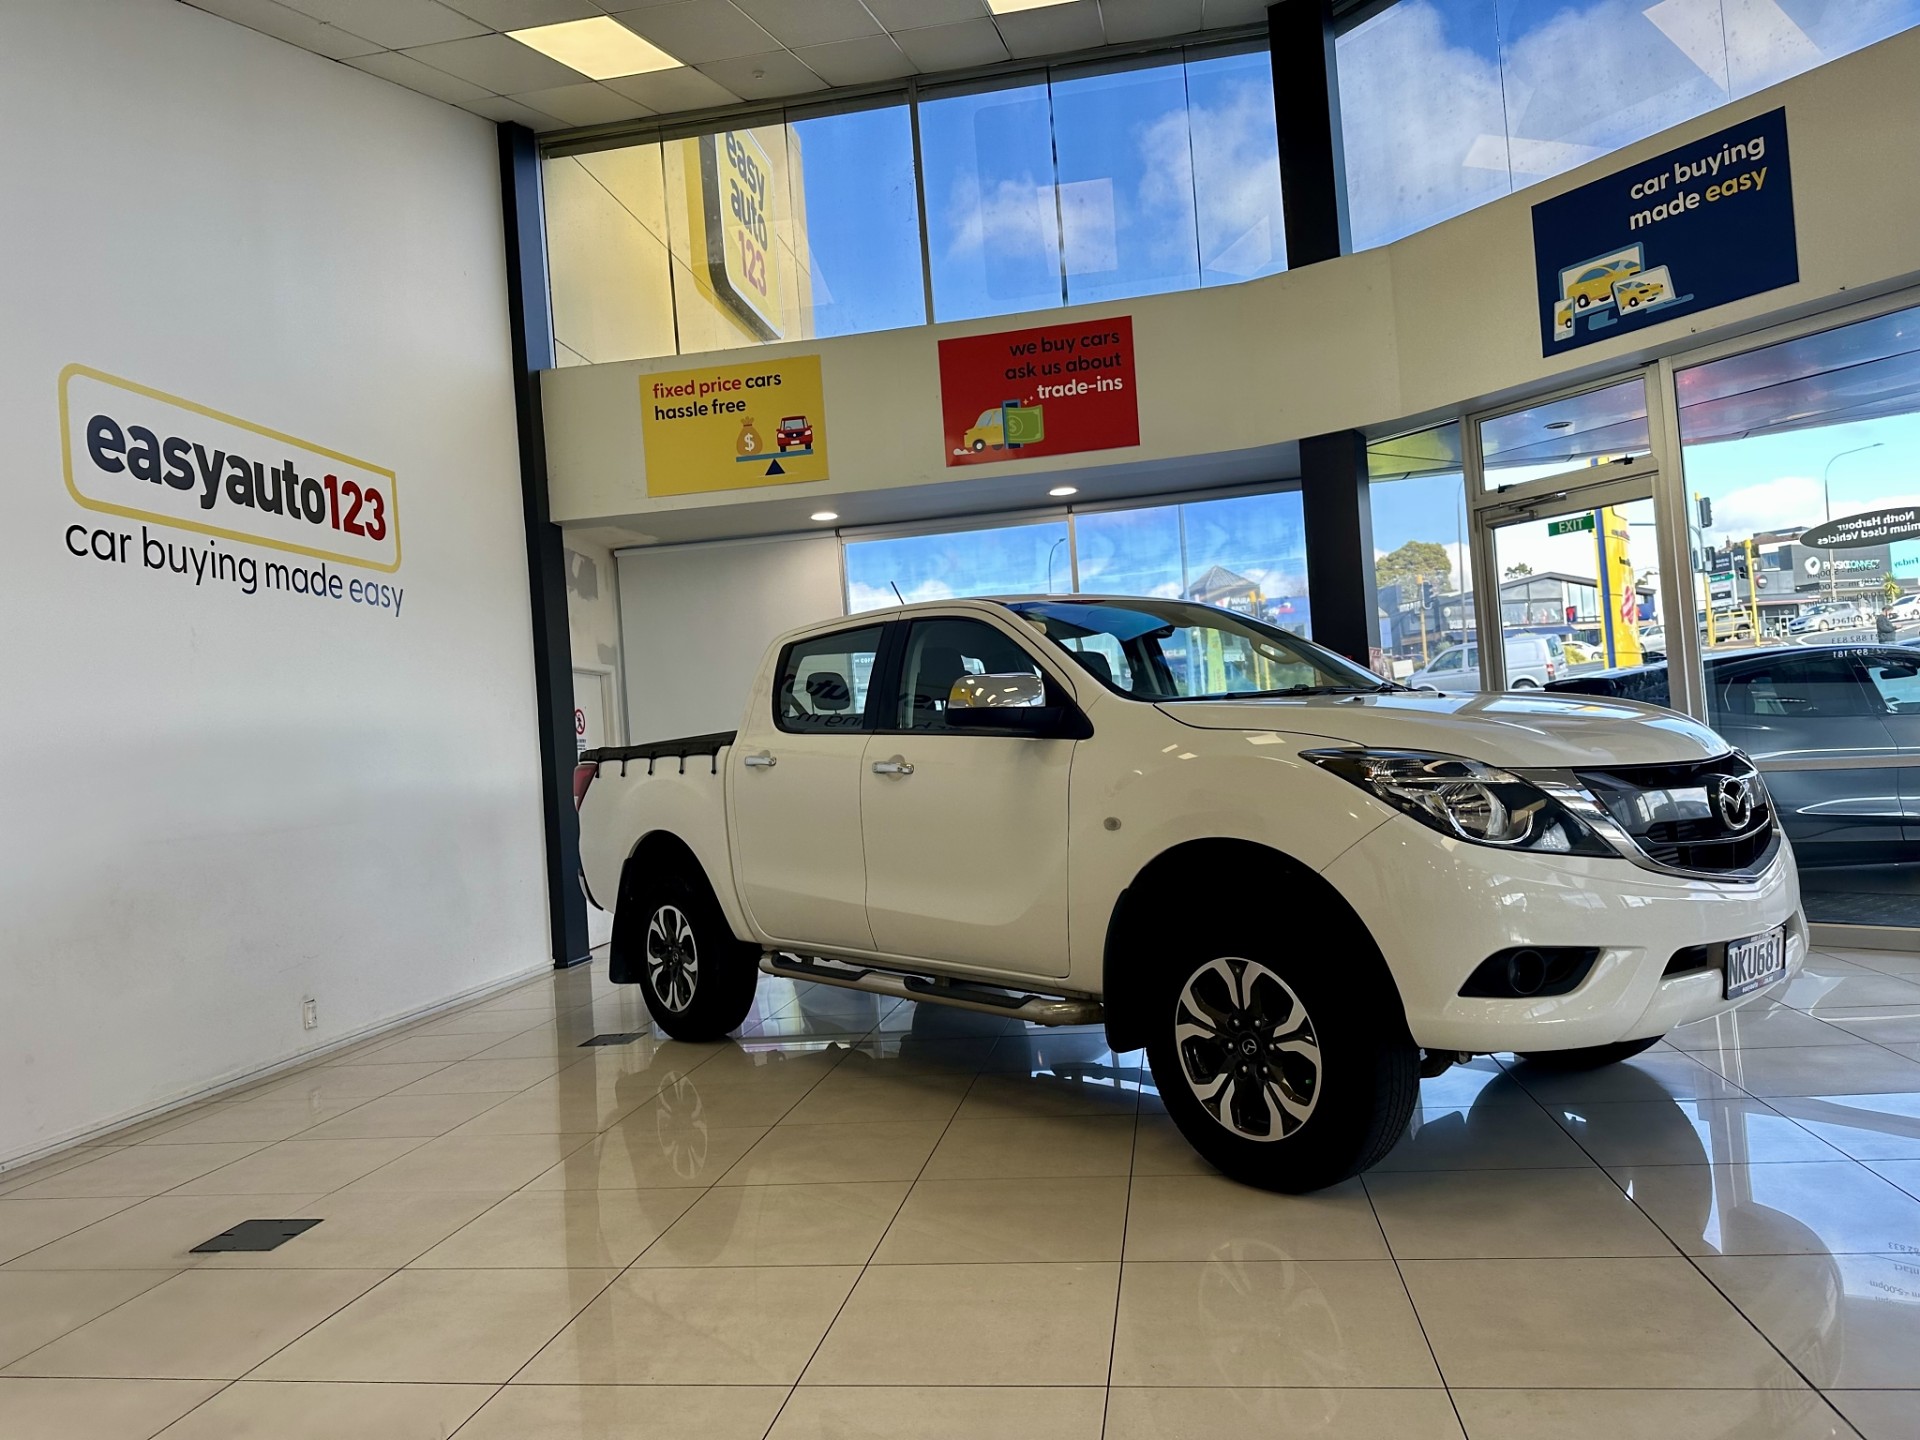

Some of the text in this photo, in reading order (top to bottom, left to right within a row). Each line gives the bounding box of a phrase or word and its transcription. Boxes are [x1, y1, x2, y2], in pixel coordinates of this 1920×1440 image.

[726, 131, 765, 212] easy
[1630, 135, 1766, 200] car buying
[730, 178, 768, 251] auto
[1629, 166, 1768, 231] made easy
[738, 230, 767, 297] 123
[1005, 352, 1122, 380] ask us about
[1009, 332, 1120, 357] we buy cars
[652, 374, 782, 399] fixed price cars
[654, 398, 746, 420] hassle free
[1037, 375, 1123, 399] trade-ins
[86, 414, 387, 541] easyauto123
[1558, 519, 1584, 533] EXIT
[65, 523, 404, 618] car buying made easy
[1728, 937, 1780, 988] NKU681
